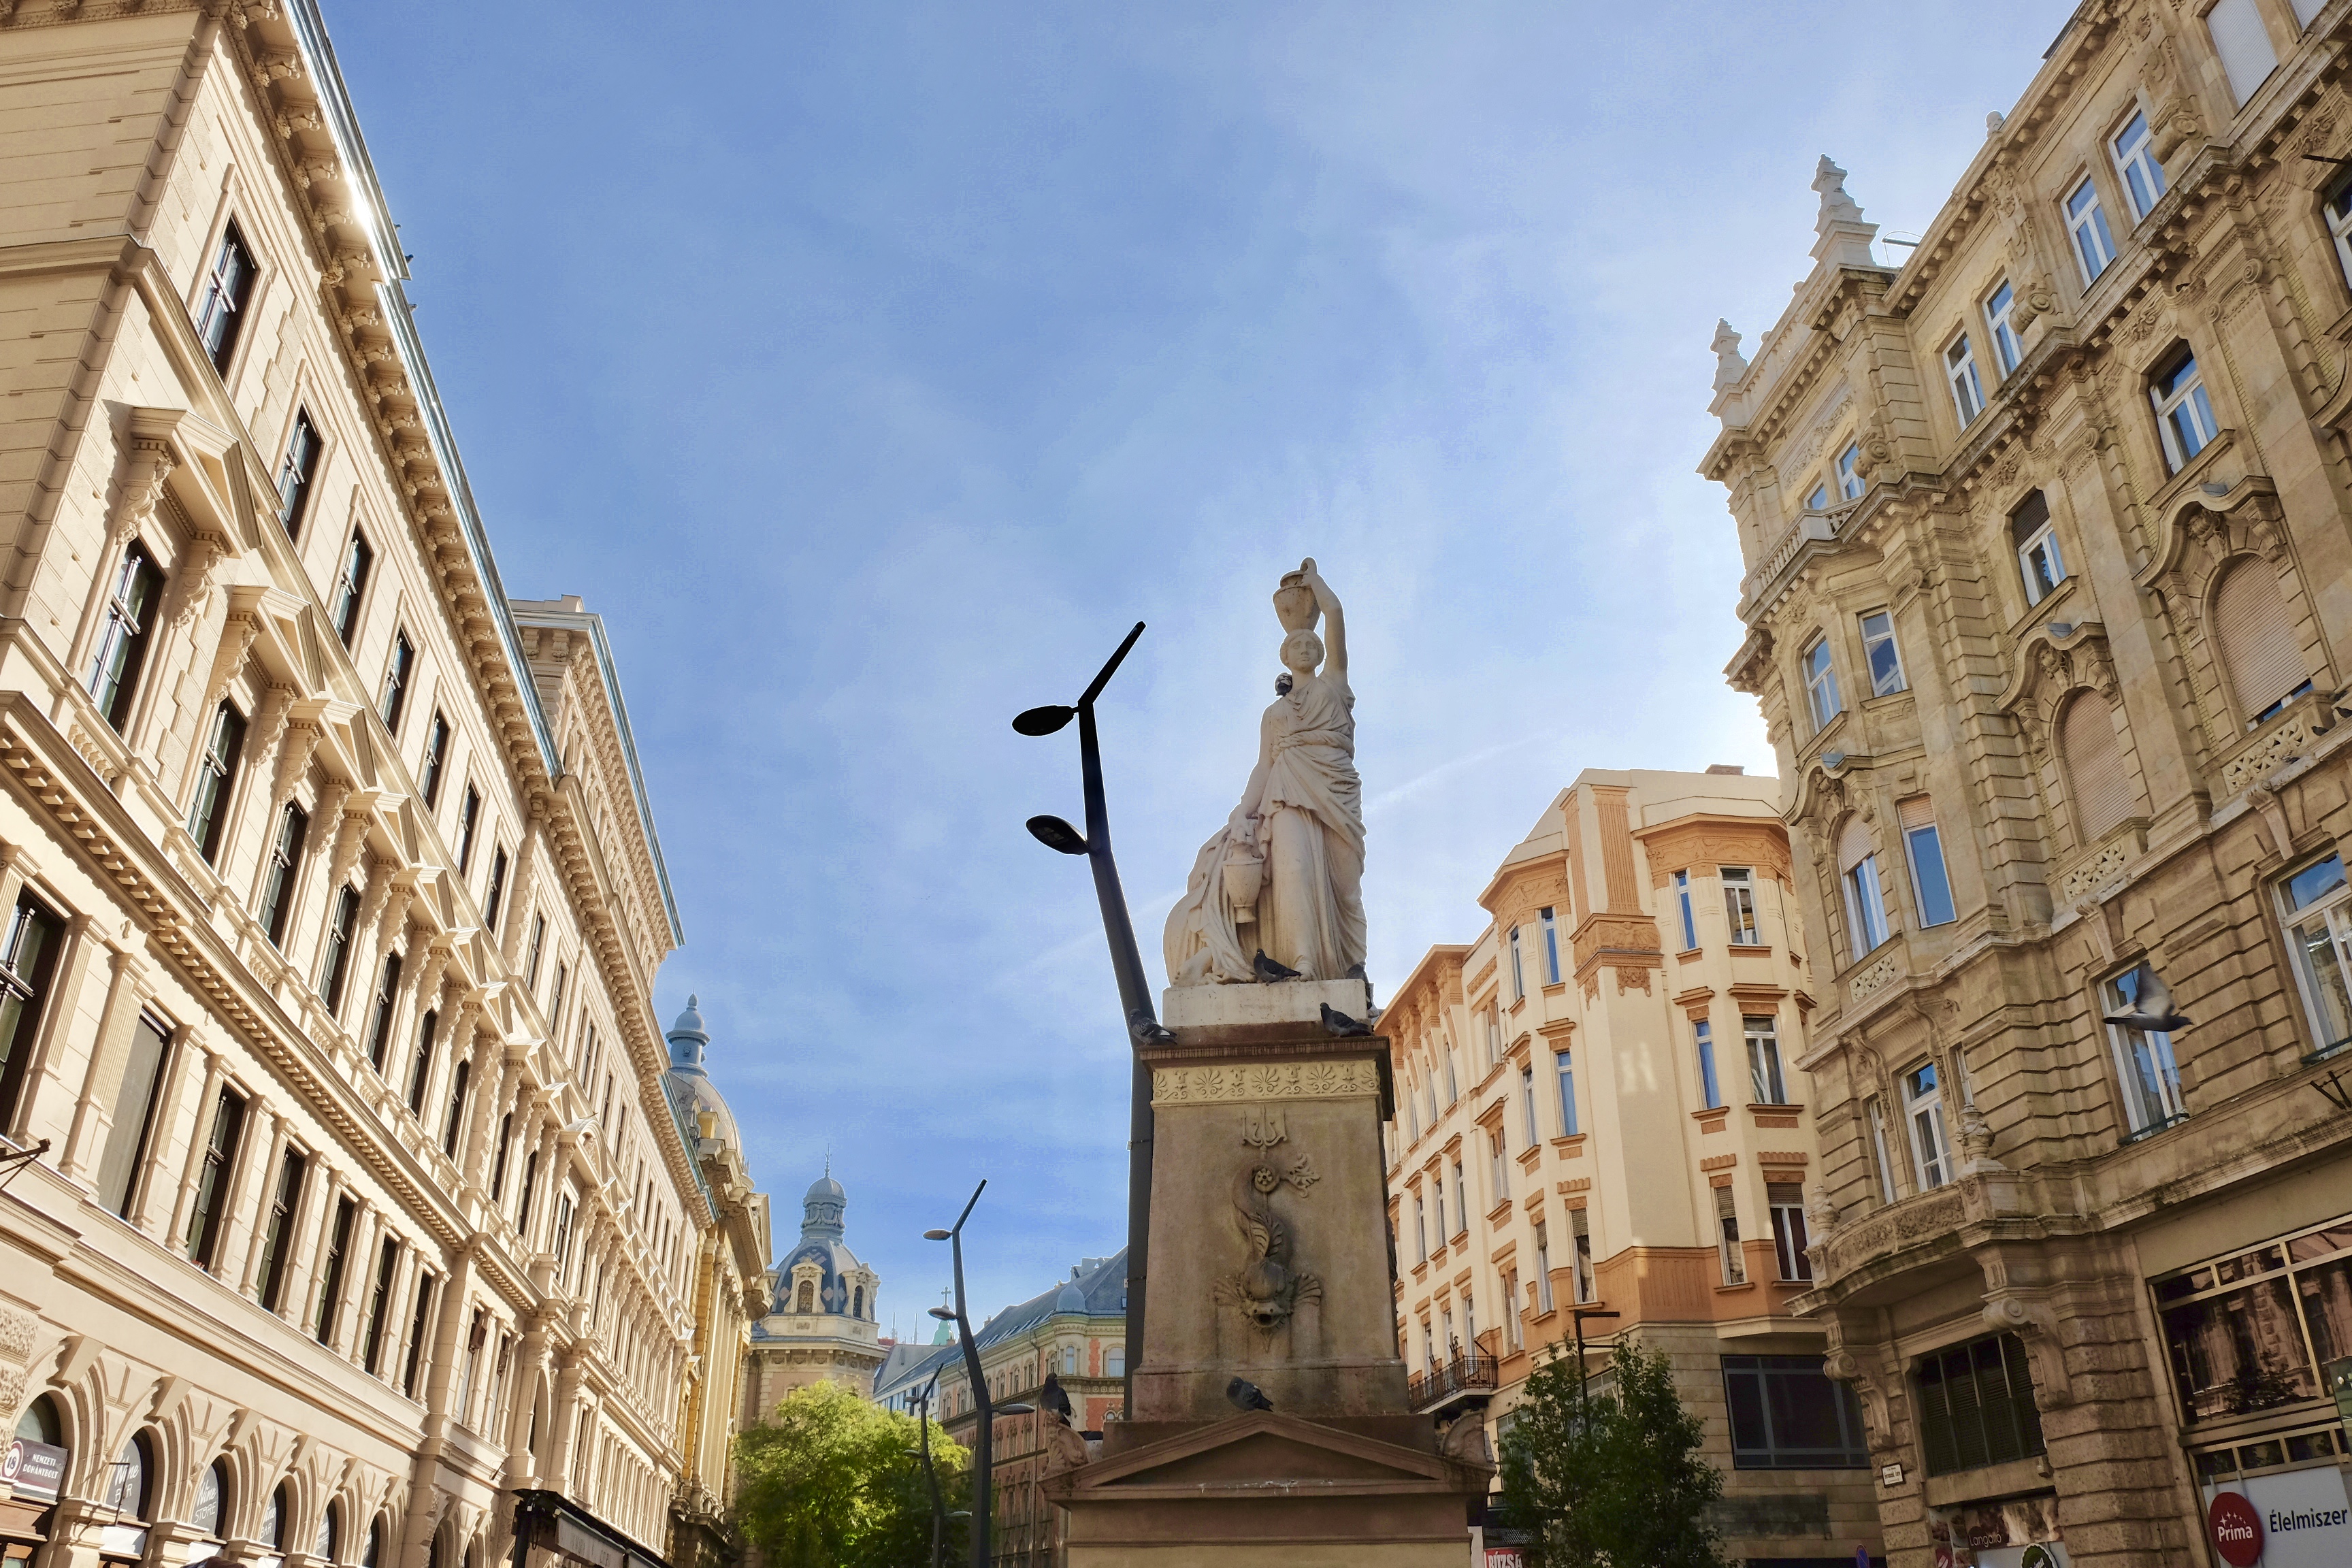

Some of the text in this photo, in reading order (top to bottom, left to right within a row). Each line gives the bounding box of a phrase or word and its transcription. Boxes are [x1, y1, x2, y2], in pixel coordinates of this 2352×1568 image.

[6, 1456, 17, 1470] 18
[32, 1453, 56, 1467] NEMZETI
[22, 1463, 59, 1480] DOHÁNYBOLT
[114, 1483, 133, 1503] BR
[193, 1501, 217, 1524] STORE
[2269, 1507, 2348, 1533] Élelmiszer
